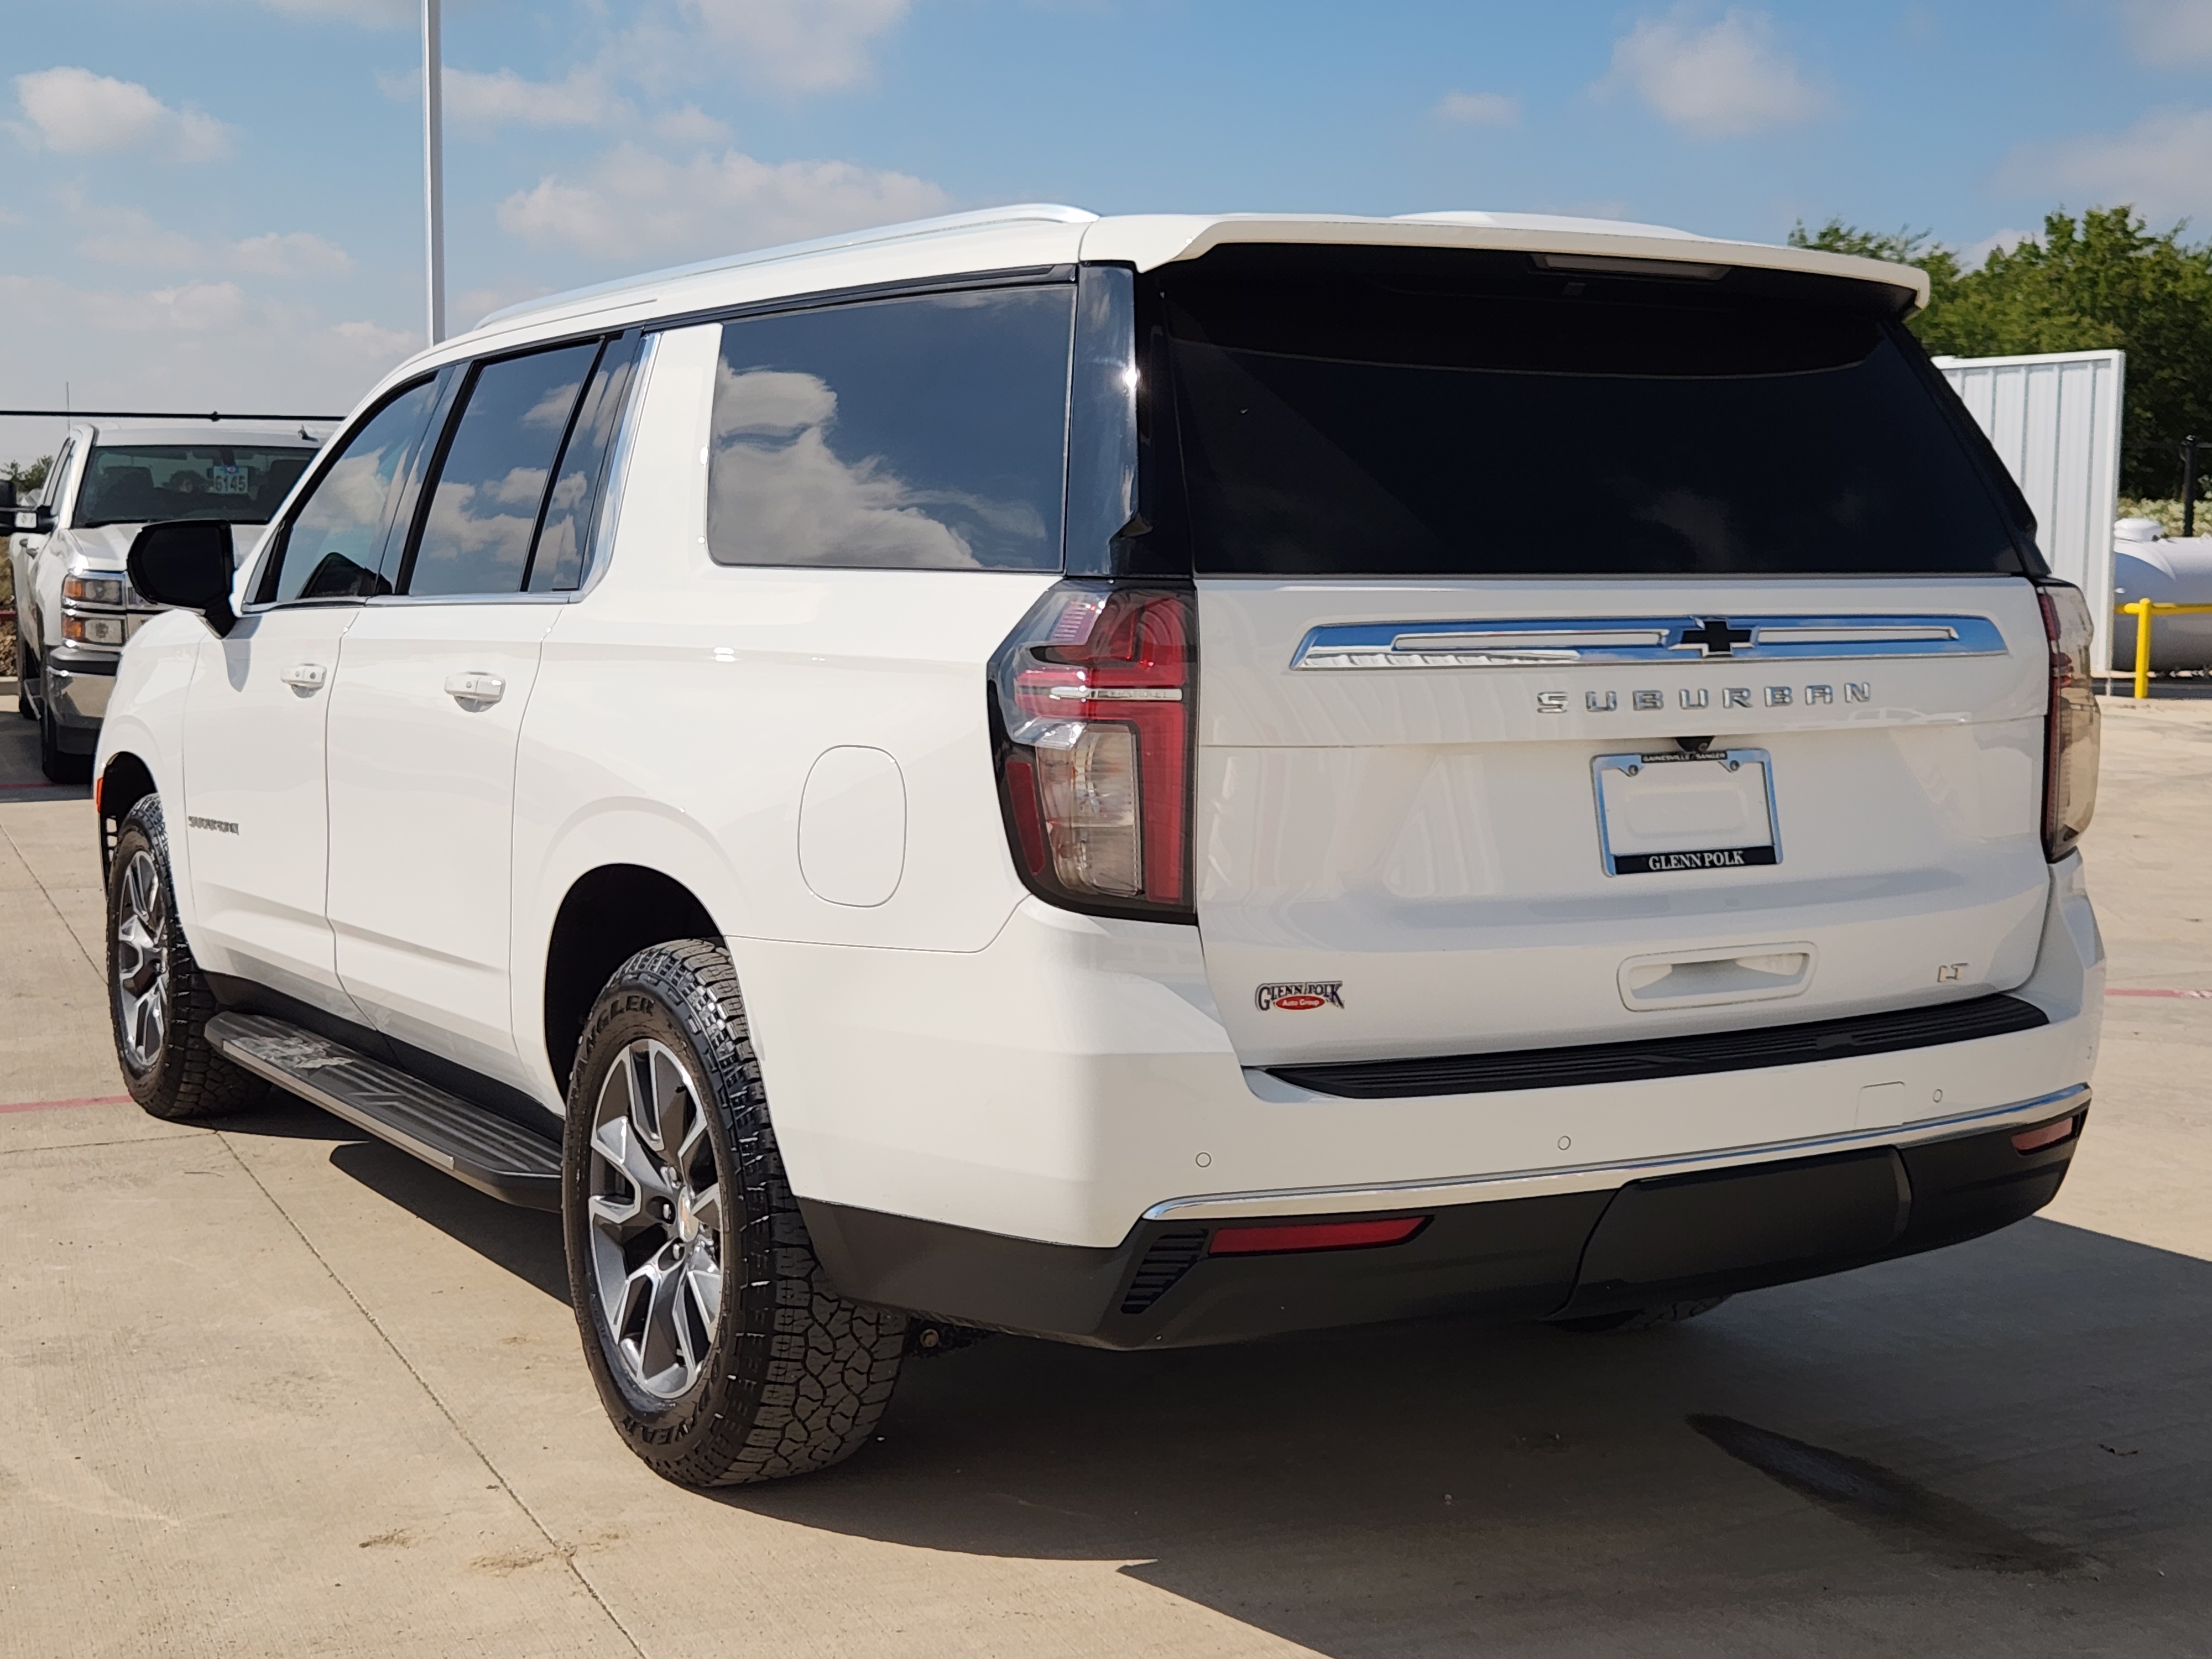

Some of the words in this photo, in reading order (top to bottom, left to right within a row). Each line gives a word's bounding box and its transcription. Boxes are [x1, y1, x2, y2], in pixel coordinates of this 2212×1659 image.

[215, 475, 246, 492] 6145
[1537, 681, 1871, 714] SUBURBAN
[1648, 853, 1703, 870] GLENN
[1703, 850, 1745, 867] POLK
[1937, 962, 1969, 983] LT
[1258, 984, 1303, 1011] GLENN
[1307, 983, 1345, 1009] POLK
[1299, 998, 1320, 1006] Group
